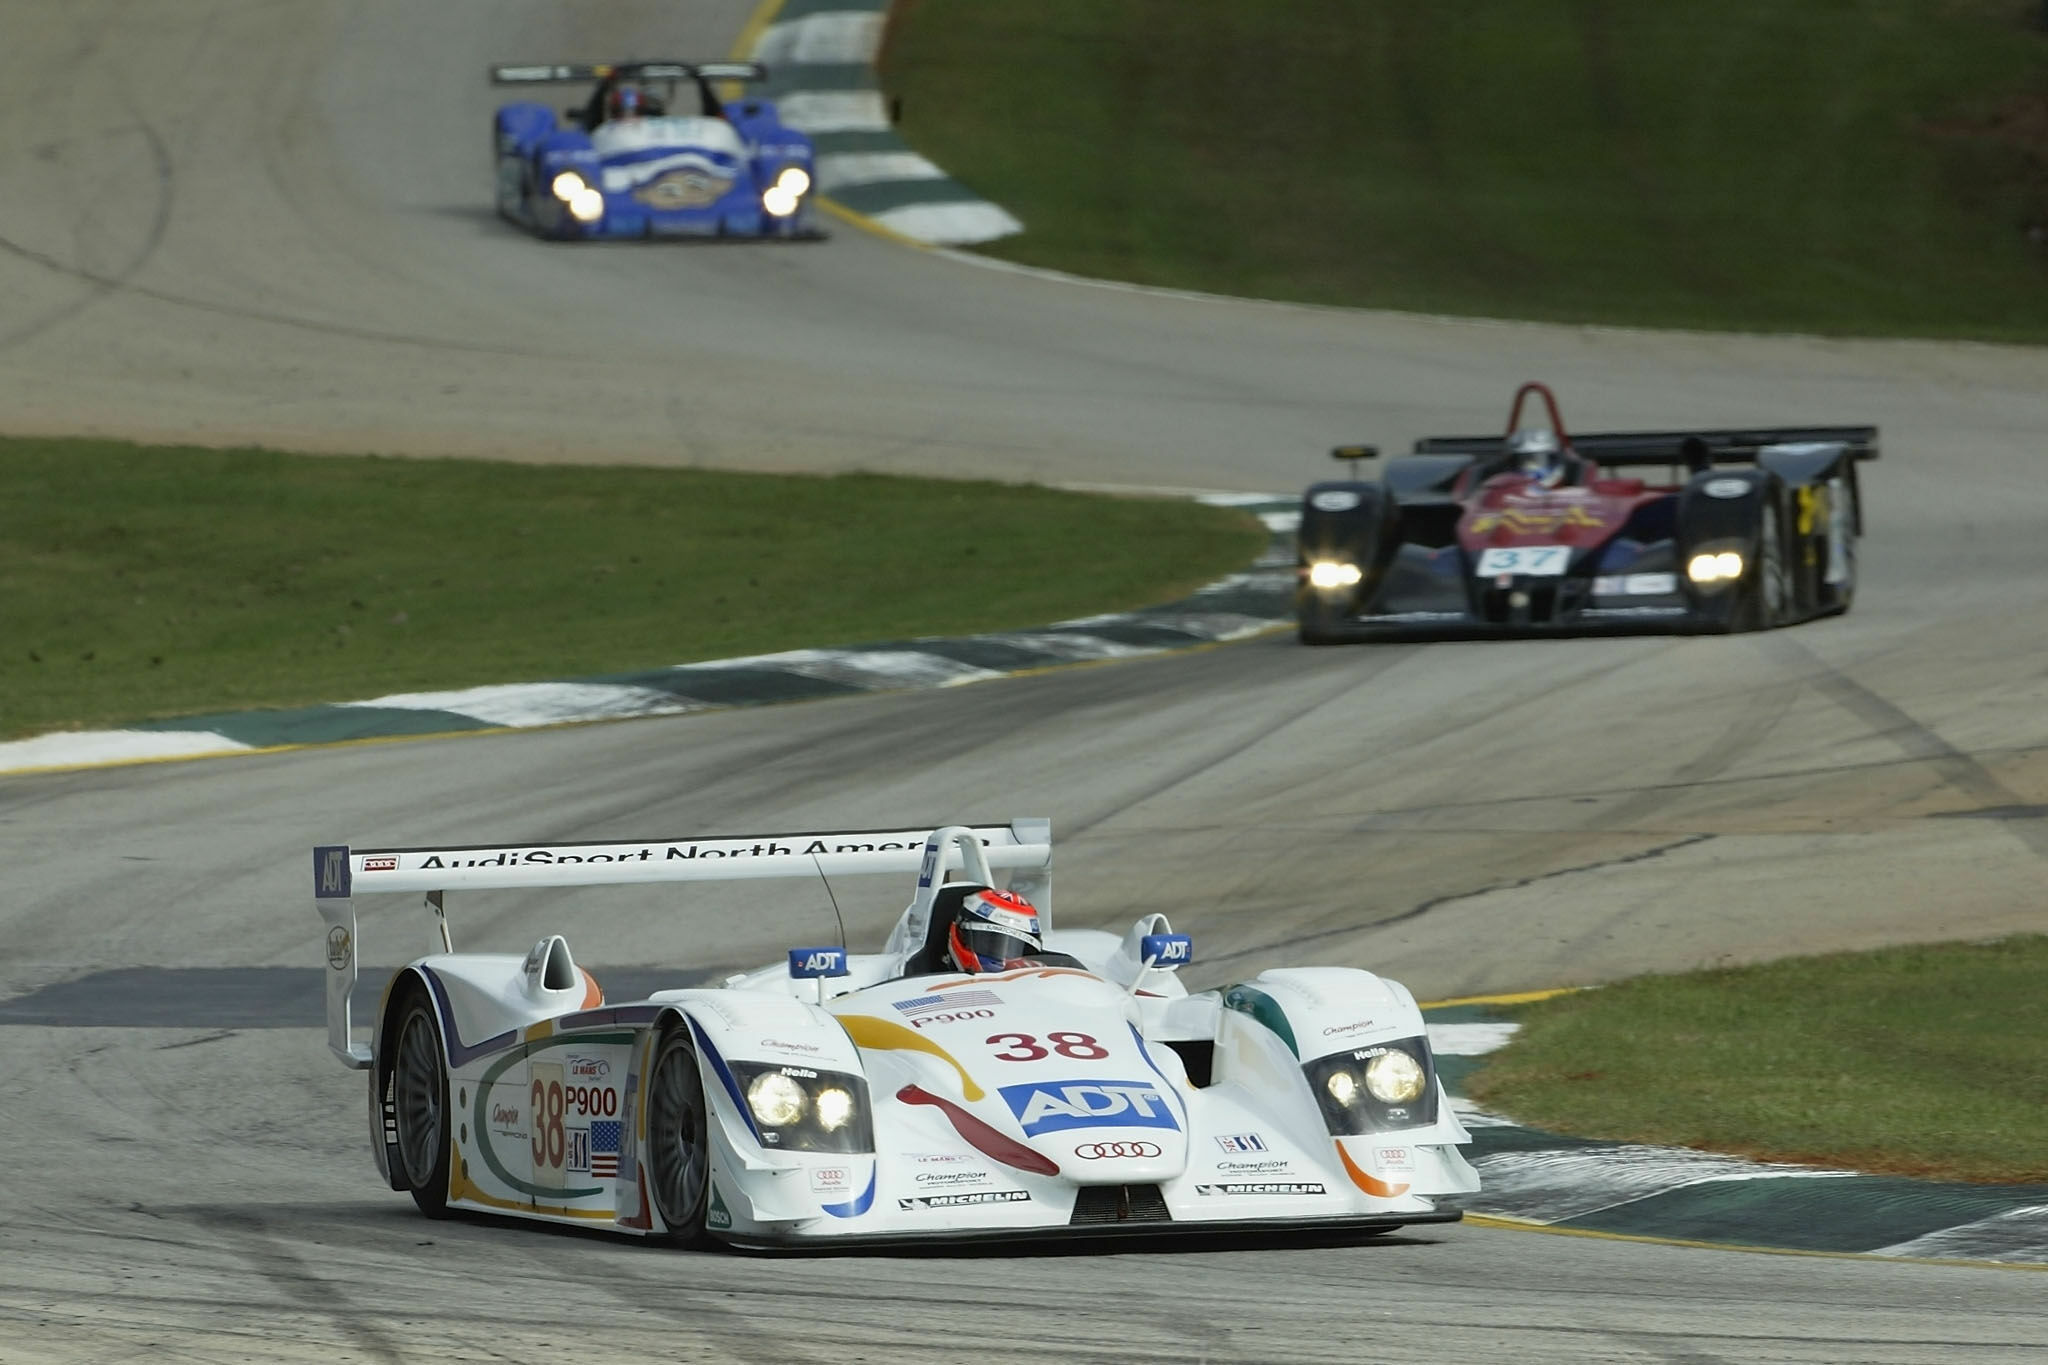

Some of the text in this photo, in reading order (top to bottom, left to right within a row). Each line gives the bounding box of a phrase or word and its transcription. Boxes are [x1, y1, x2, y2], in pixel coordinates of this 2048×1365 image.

[1488, 550, 1557, 569] 37
[665, 842, 792, 861] North
[322, 851, 343, 892] ADT
[1161, 941, 1188, 959] ADT
[805, 952, 841, 971] ADT
[910, 1008, 995, 1029] P900
[985, 1031, 1110, 1063] 38
[1354, 1047, 1388, 1061] Hella
[781, 1067, 818, 1079] Hella
[565, 1086, 617, 1117] P900
[1019, 1085, 1161, 1126] ADT
[531, 1079, 565, 1169] 38
[1216, 1160, 1289, 1173] Champion
[915, 1171, 987, 1183] Champion
[1226, 1184, 1324, 1194] MICHELIN
[929, 1191, 1028, 1207] MICHELIN
[709, 1209, 730, 1225] BOSCH
